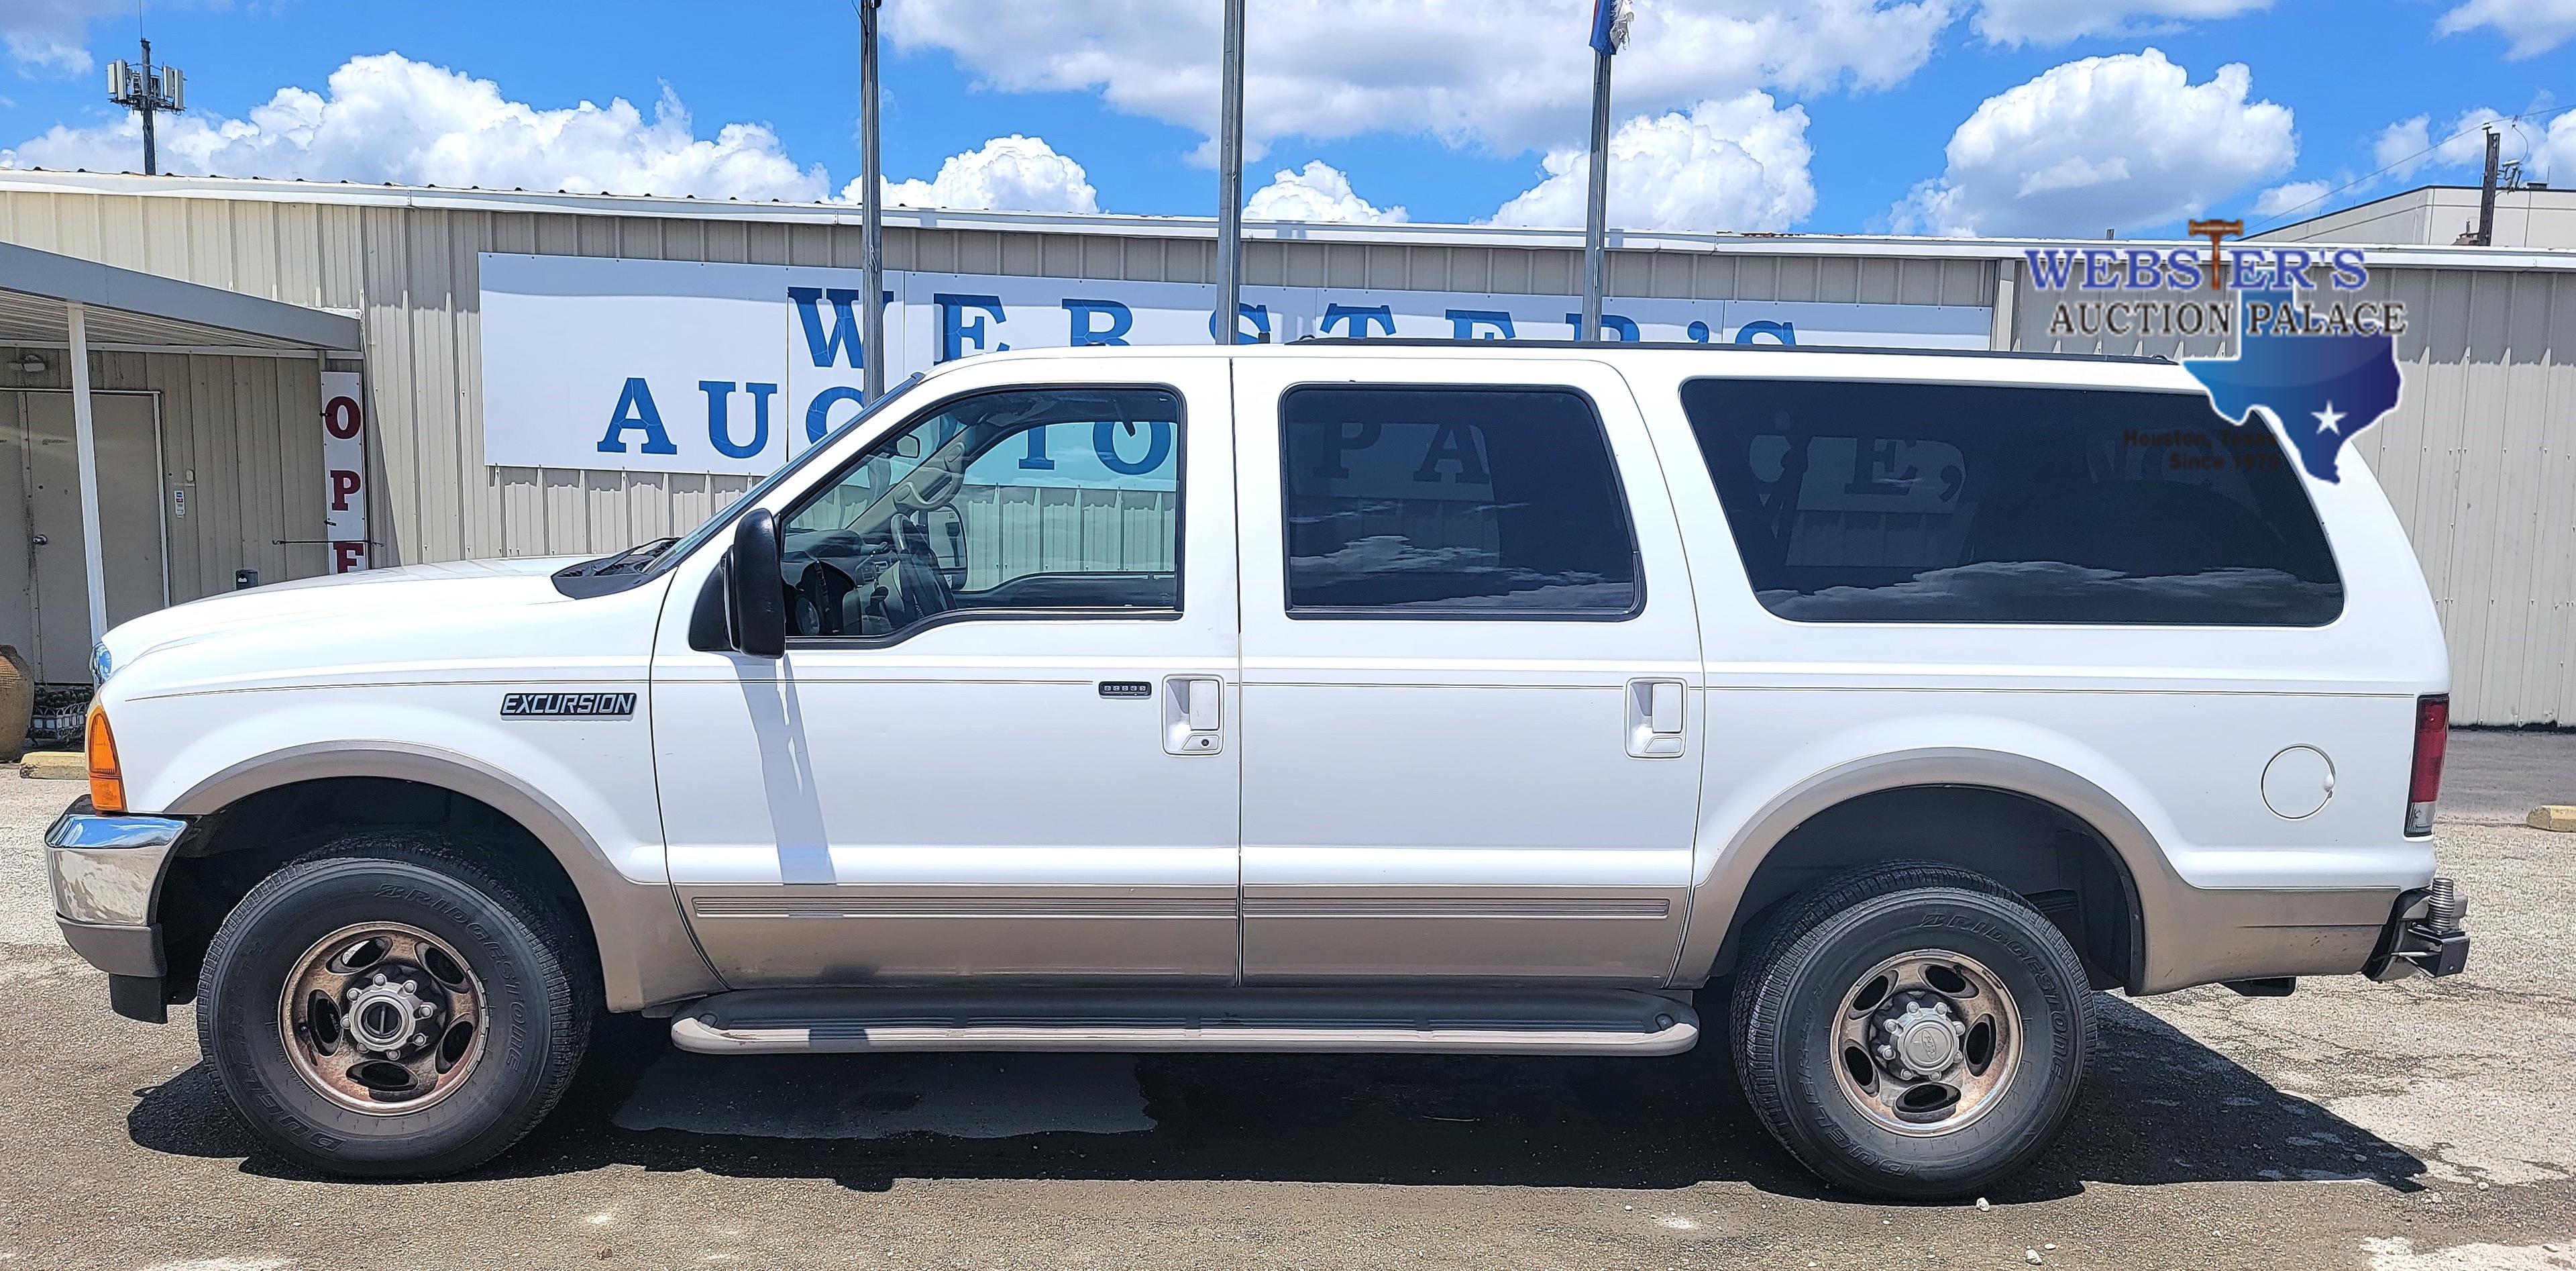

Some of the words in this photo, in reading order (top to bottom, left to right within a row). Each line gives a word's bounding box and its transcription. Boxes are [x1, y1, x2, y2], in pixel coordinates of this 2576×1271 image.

[502, 694, 634, 713] EXCURSION
[374, 882, 527, 1072] BRIDGESTONE
[1918, 913, 2070, 1079] BRIDGESTONE
